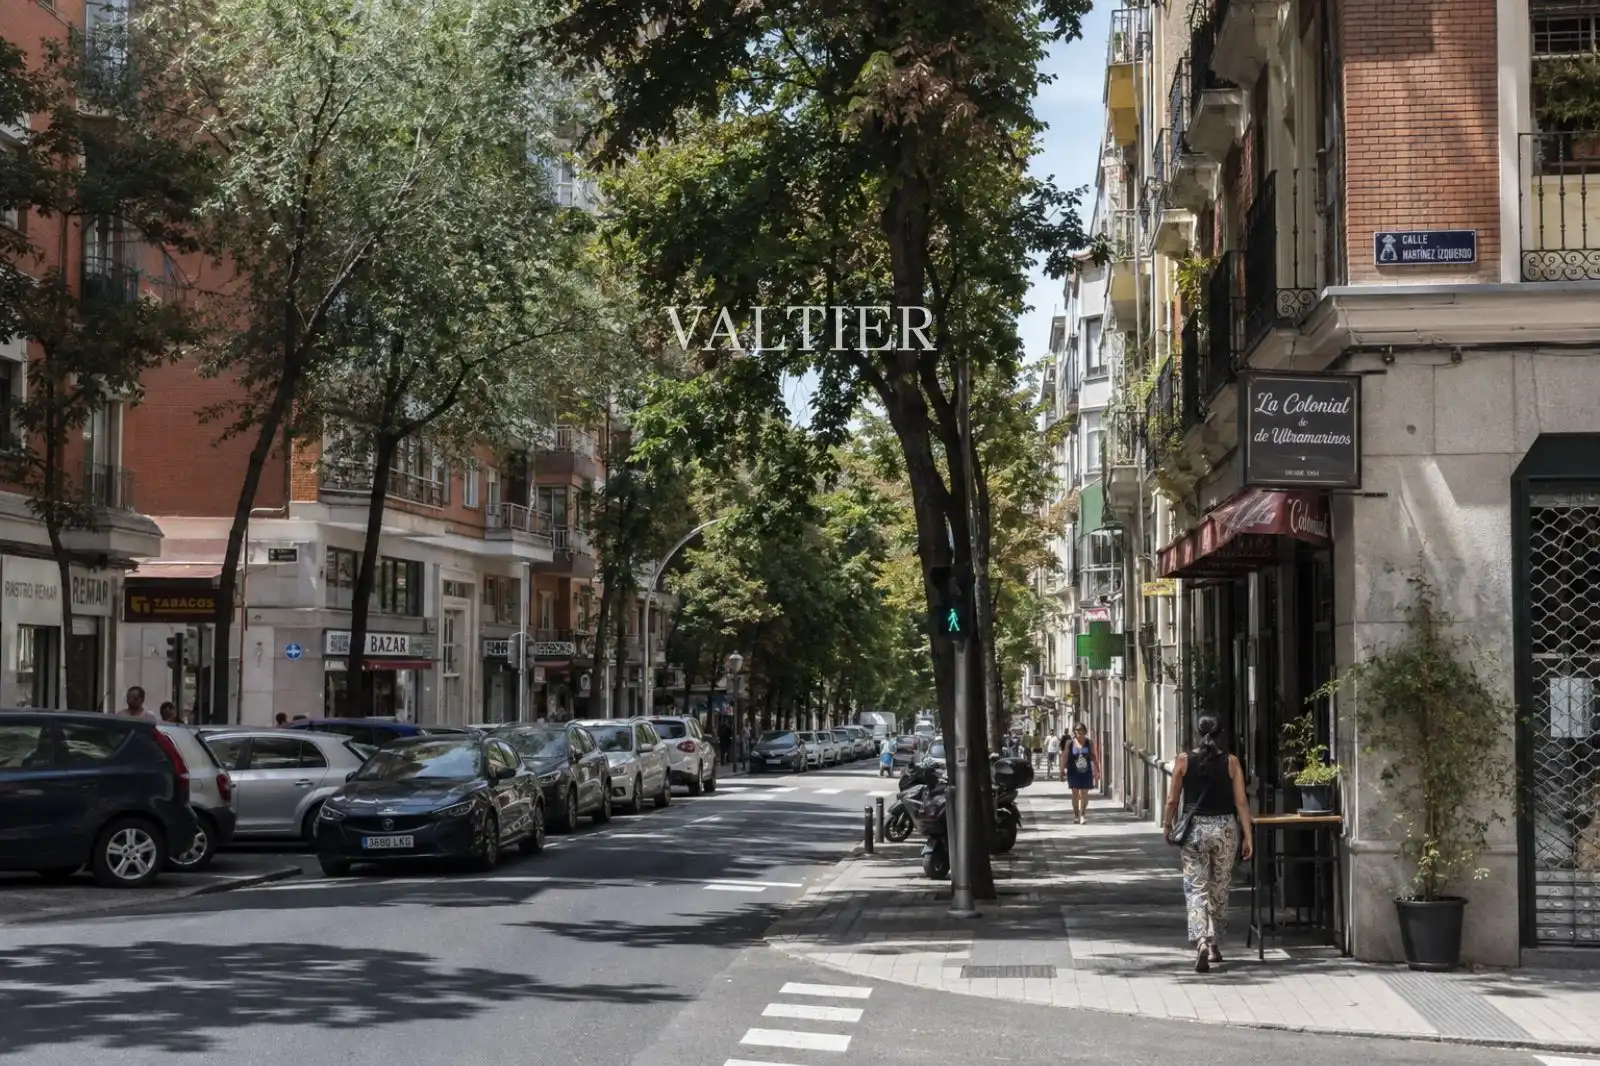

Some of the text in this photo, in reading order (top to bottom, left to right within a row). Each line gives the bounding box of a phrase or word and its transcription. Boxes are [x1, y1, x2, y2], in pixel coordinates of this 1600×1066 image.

[1402, 234, 1428, 245] CALLE
[1254, 392, 1351, 417] La Colonial
[1254, 427, 1351, 445] de Ultramarinos
[4, 581, 34, 599] RASTRO
[153, 597, 214, 608] TABACOS
[371, 635, 406, 653] BAZAR
